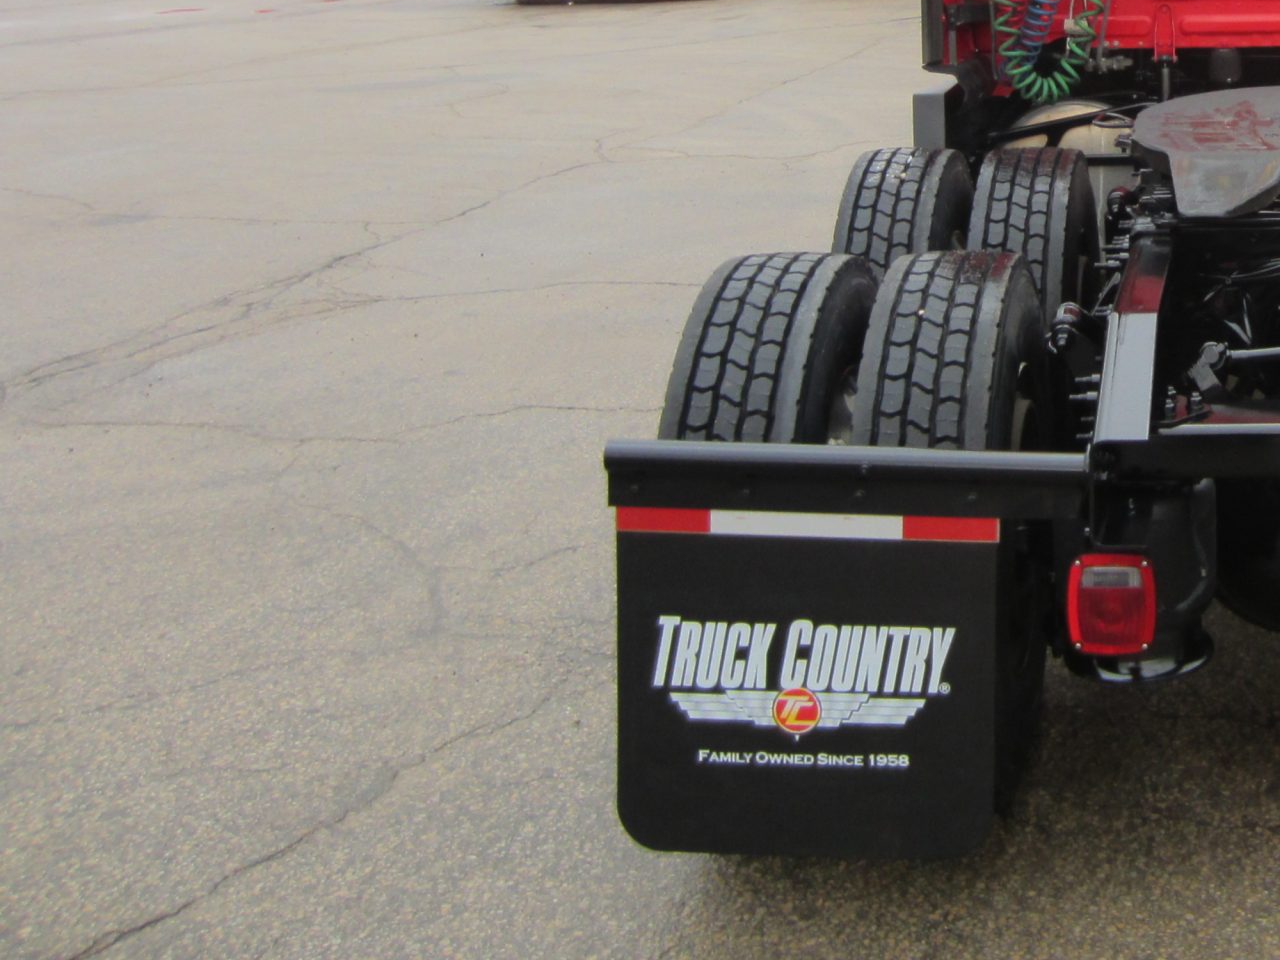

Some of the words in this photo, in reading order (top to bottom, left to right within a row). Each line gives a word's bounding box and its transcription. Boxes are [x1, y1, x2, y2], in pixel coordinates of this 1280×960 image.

[652, 615, 777, 689] TRUCK
[698, 749, 753, 764] FAMILY
[755, 751, 814, 766] OWNED
[817, 752, 864, 767] SINCE
[868, 754, 910, 767] 1958
